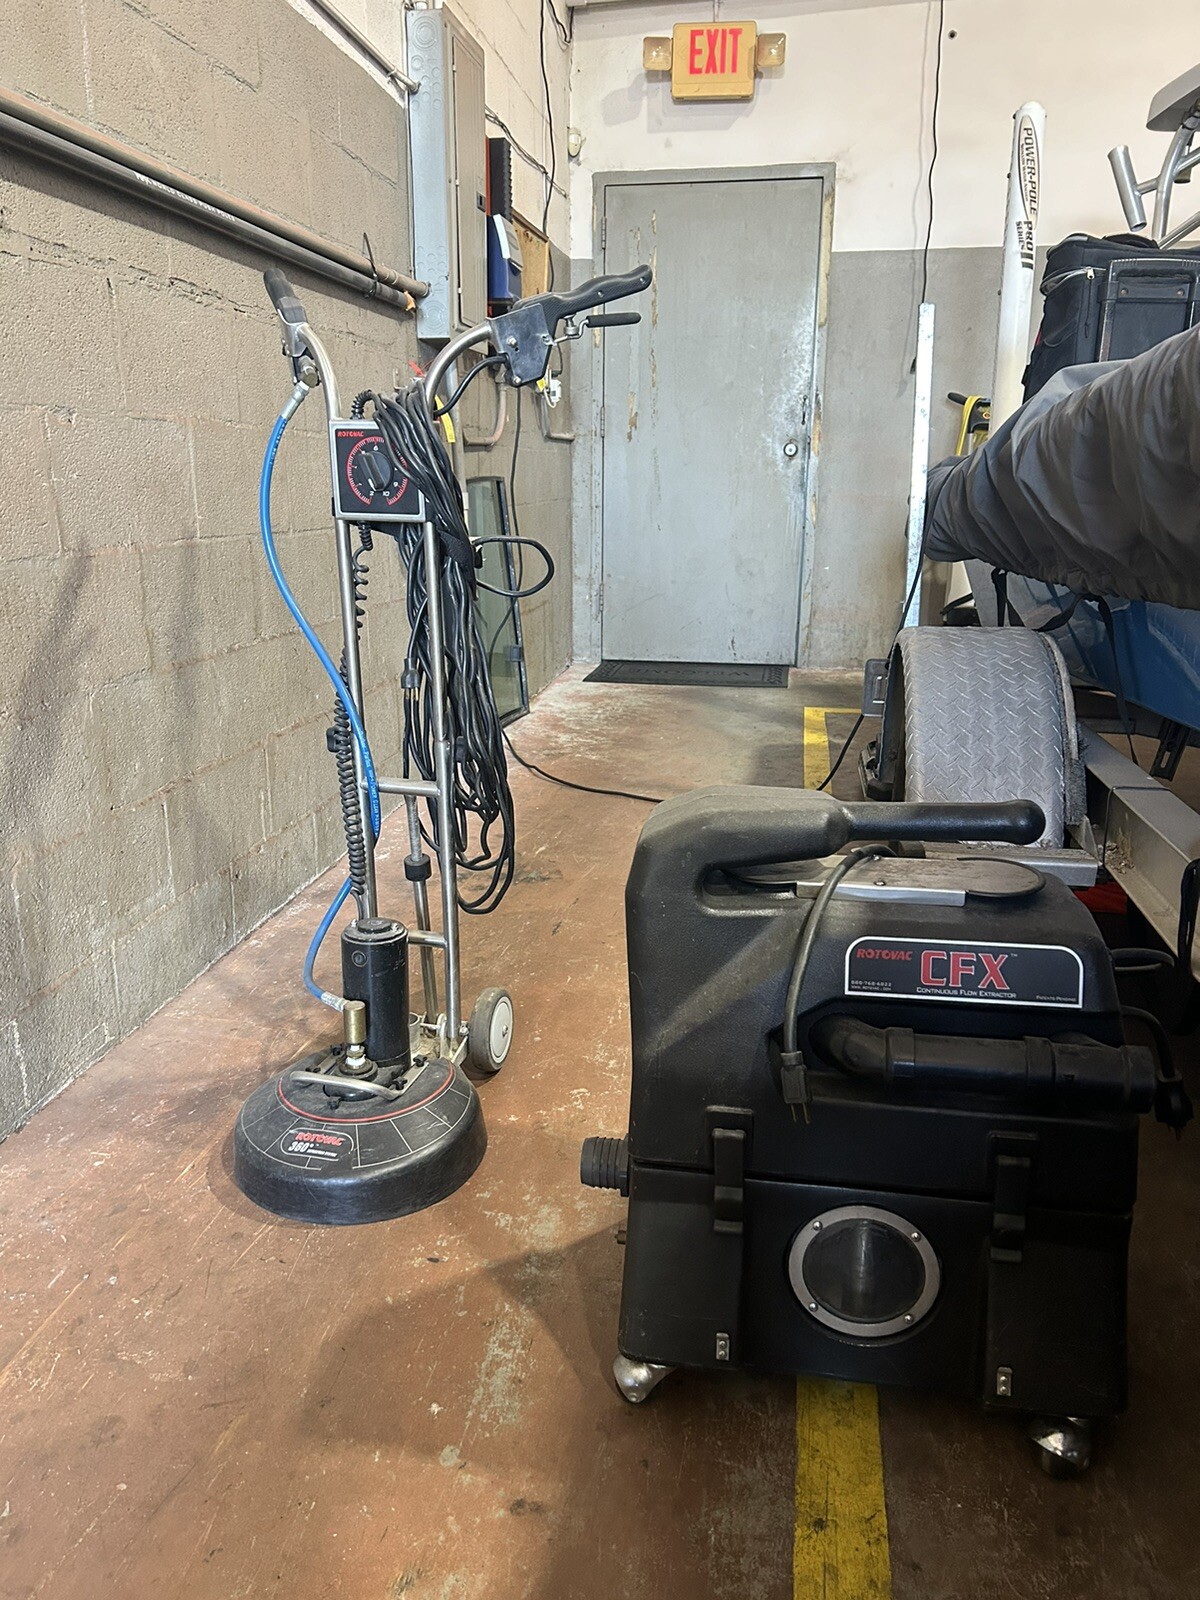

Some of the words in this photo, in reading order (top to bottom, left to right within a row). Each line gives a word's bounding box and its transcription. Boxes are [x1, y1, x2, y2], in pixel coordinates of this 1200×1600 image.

[689, 28, 743, 75] EXIT
[1023, 127, 1037, 215] POWER-POLE
[1023, 220, 1034, 252] PRO
[856, 948, 913, 961] ROTOVAC
[920, 950, 1010, 990] CFX
[916, 986, 959, 996] CONTINUOUS
[959, 989, 978, 997] FLOW
[979, 990, 1017, 999] EXTRACTOR
[294, 1131, 345, 1146] ROTOVAC
